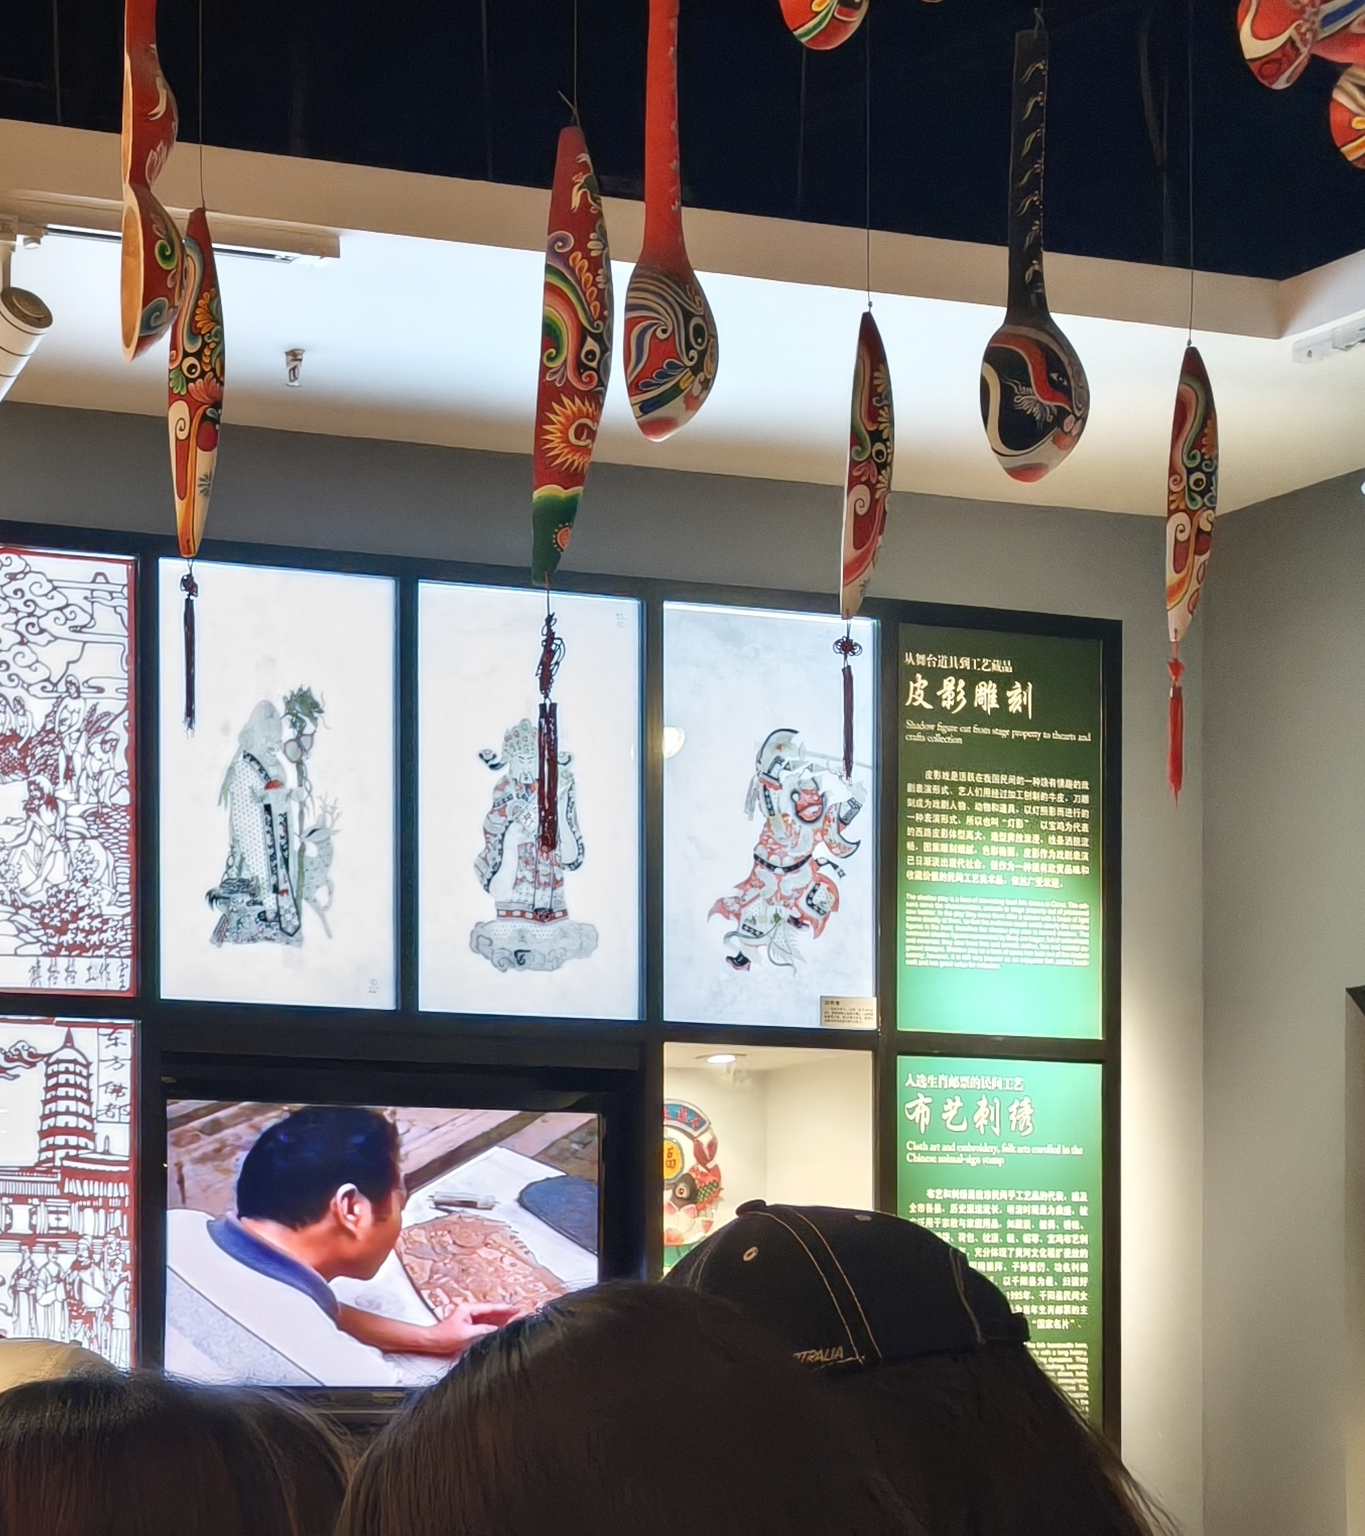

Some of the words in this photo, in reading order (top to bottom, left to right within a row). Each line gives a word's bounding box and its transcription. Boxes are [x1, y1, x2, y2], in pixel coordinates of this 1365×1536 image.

[905, 673, 1033, 720] 皮影雕刻
[904, 1093, 1035, 1137] 布艺刺绣
